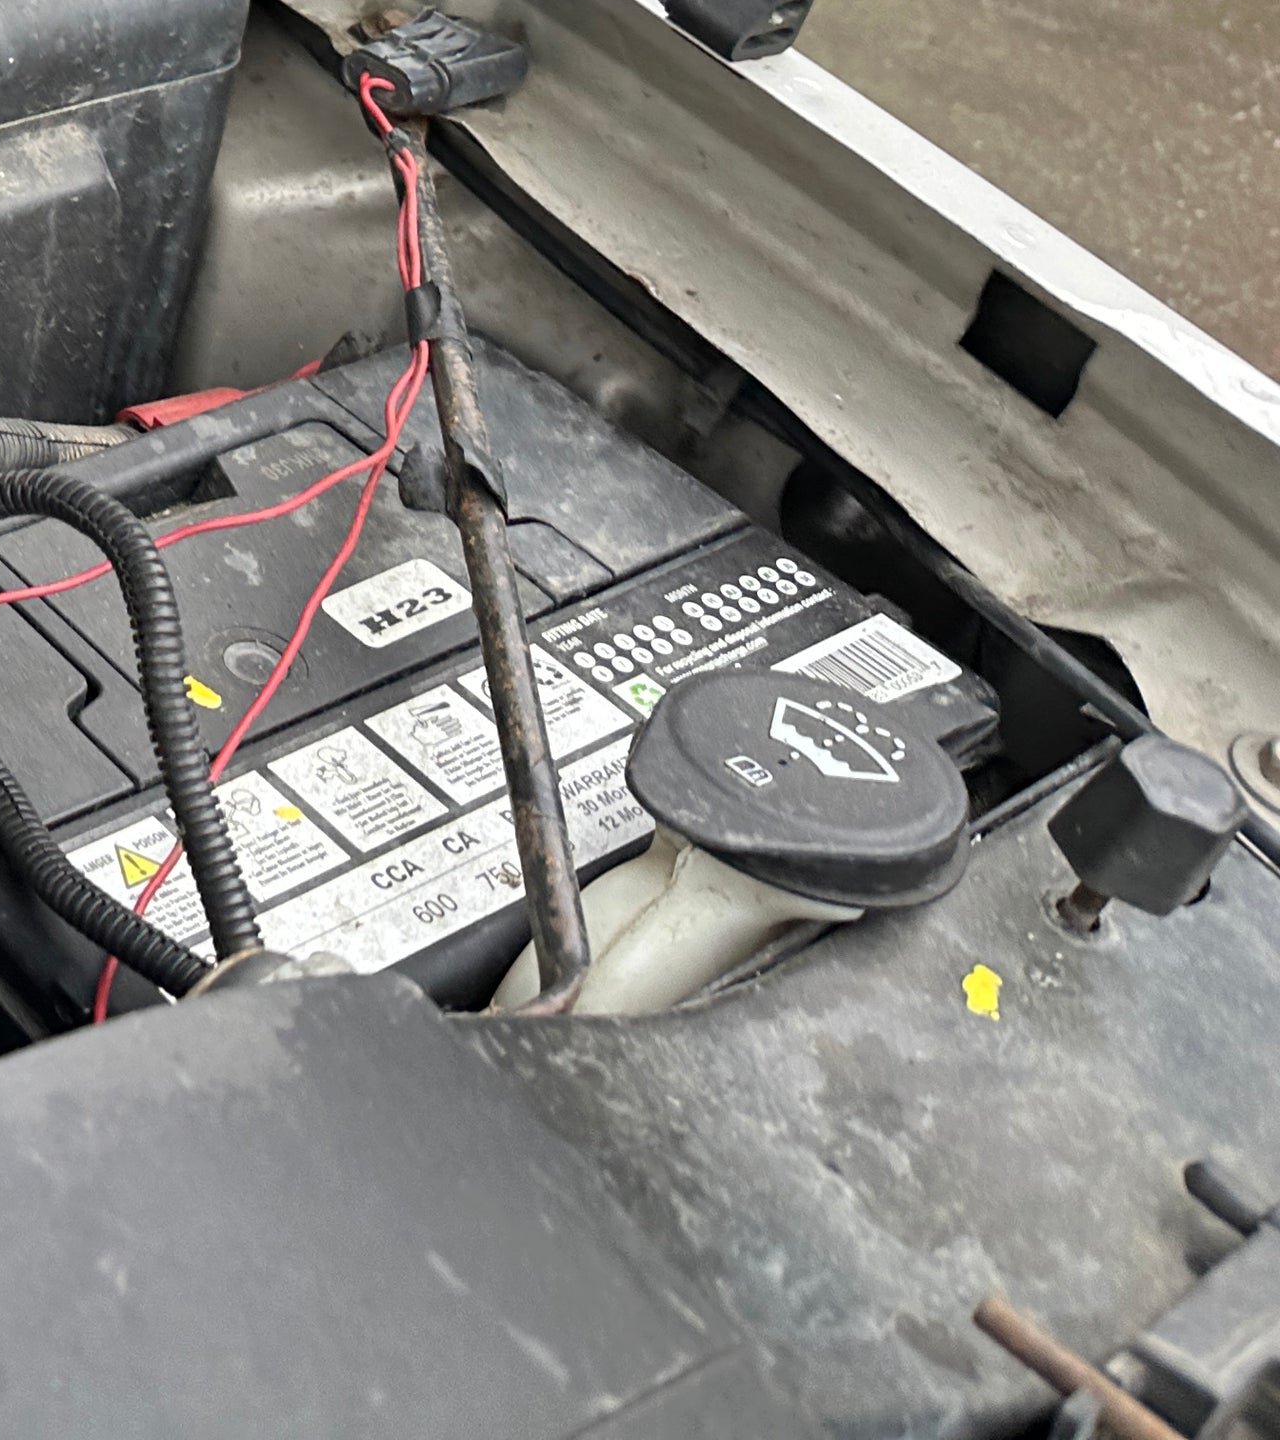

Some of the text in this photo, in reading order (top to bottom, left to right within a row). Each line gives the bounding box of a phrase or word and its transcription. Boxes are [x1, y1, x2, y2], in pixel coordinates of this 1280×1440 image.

[358, 587, 453, 636] H23
[580, 607, 609, 629] DATE
[556, 636, 583, 653] YEAR
[577, 799, 599, 817] 30
[598, 814, 620, 833] 12
[79, 852, 115, 874] ANGER
[370, 859, 425, 891] CCA
[442, 830, 481, 856] CA
[412, 860, 523, 925] 600 750
